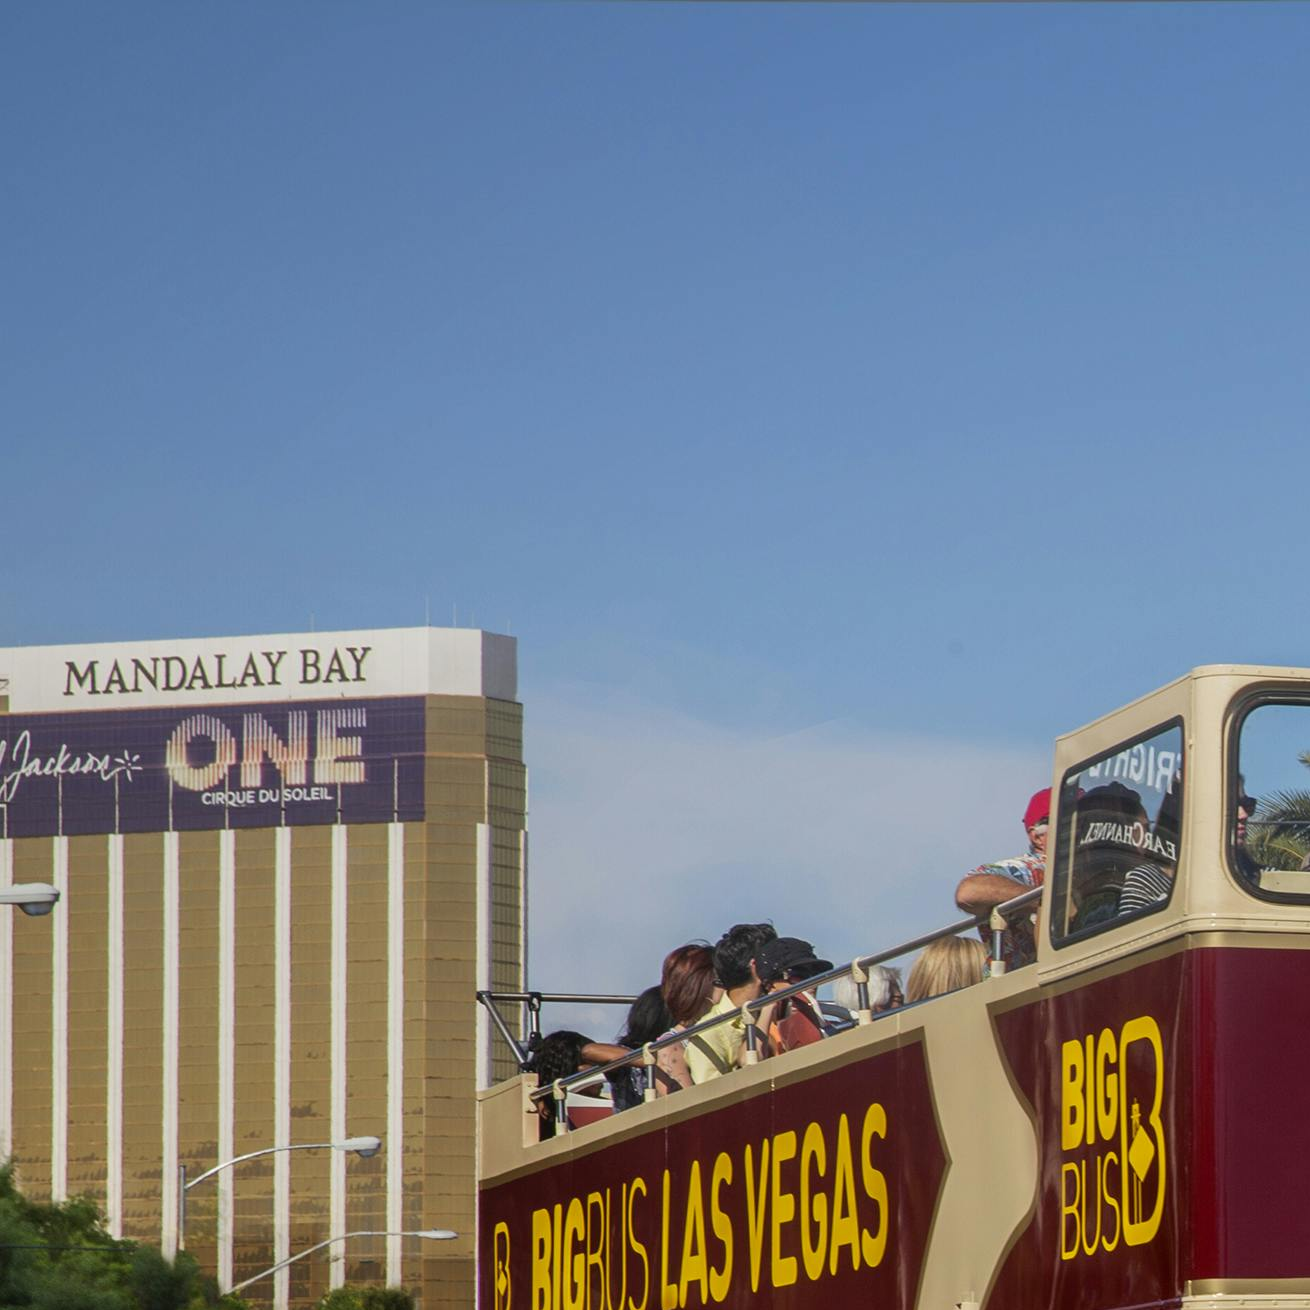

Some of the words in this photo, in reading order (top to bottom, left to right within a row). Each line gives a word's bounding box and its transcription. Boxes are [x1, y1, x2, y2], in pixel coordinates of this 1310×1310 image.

[62, 651, 287, 695] MANDALAY
[298, 646, 372, 684] BAY
[1, 729, 116, 802] Jackson
[165, 707, 367, 792] ONE
[201, 790, 256, 808] CIRQUE
[259, 788, 280, 802] DU
[283, 786, 335, 803] SOLEIL
[1061, 1027, 1119, 1153] BIG
[743, 1102, 890, 1293] VEGAS
[1061, 1150, 1120, 1261] BUS
